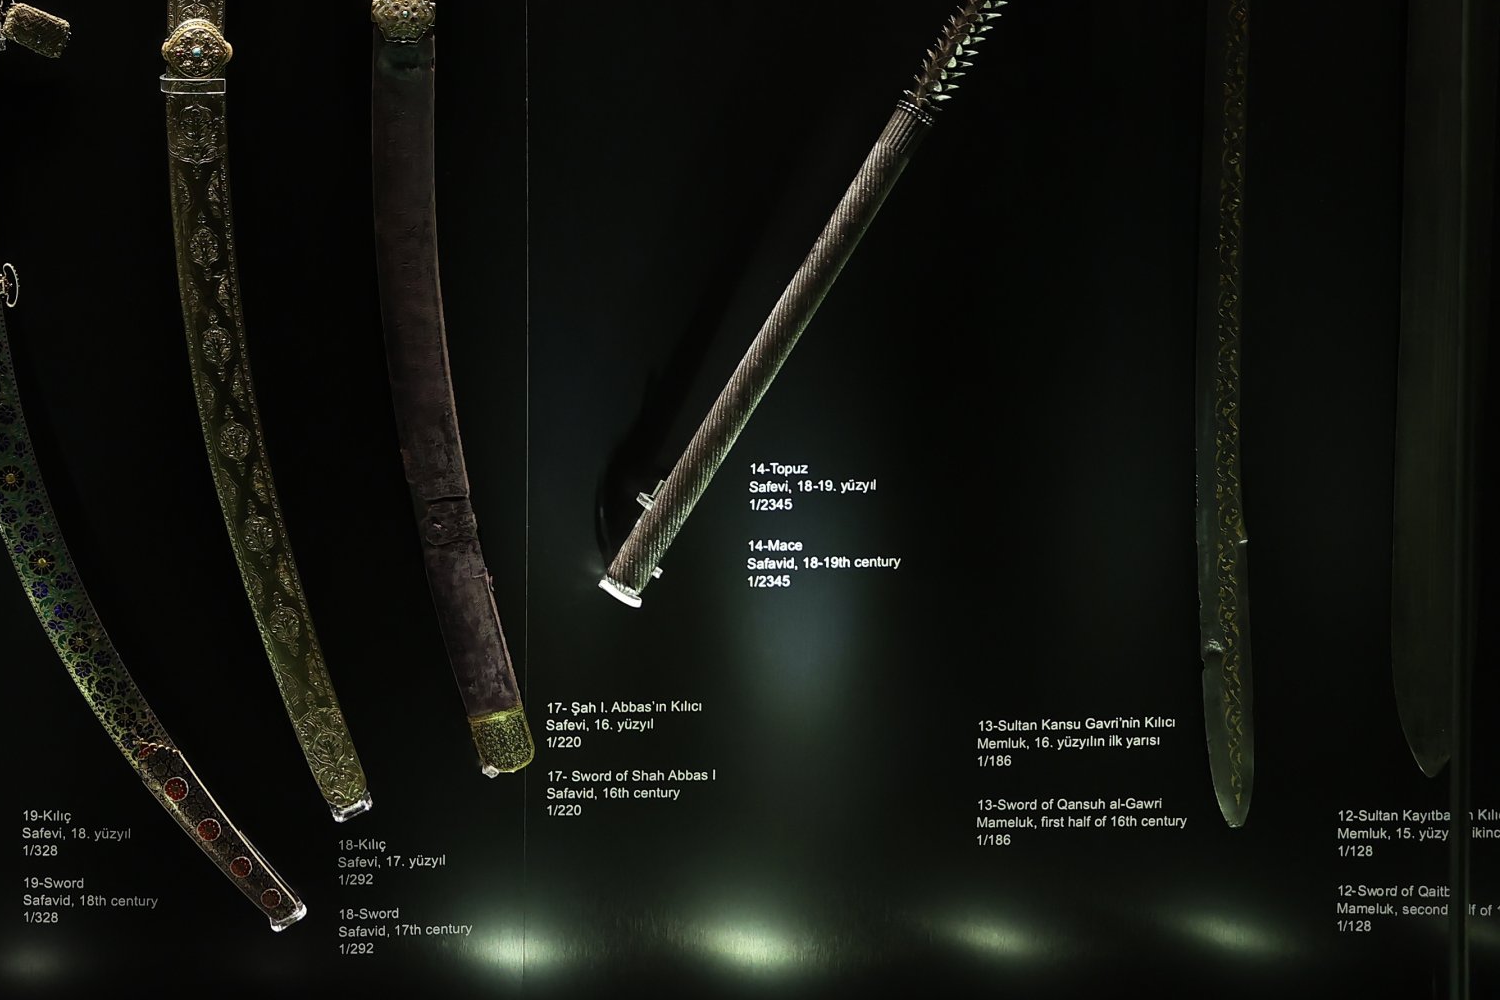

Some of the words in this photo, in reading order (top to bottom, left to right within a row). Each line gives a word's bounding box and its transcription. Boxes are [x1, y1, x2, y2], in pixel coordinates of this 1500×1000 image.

[750, 462, 809, 477] 14-Topuz
[748, 480, 792, 494] Safevi,
[797, 479, 837, 492] 18-19.
[749, 498, 793, 511] 1/2345
[748, 539, 803, 552] 14-Mace
[747, 557, 798, 571] Safavid,
[803, 556, 851, 569] 18-19th
[854, 556, 901, 570] century
[747, 575, 791, 588] 1/2345
[547, 702, 567, 714] 17-
[571, 701, 596, 716] Şah
[545, 719, 589, 732] Safevi,
[594, 718, 613, 730] 16.
[978, 719, 1037, 732] 13-Sultan
[1041, 718, 1081, 730] Kansu
[546, 736, 582, 748] 1/220
[977, 737, 1030, 750] Memluk,
[1035, 736, 1053, 748] 16.
[1109, 734, 1123, 747] ilk
[977, 754, 1012, 767] 1/186
[548, 770, 568, 782] 17-
[571, 770, 612, 782] Sword
[615, 770, 629, 782] of
[631, 770, 665, 782] Shah
[667, 769, 708, 781] Abbas
[546, 787, 597, 800] Safavid,
[603, 787, 629, 799] 16th
[633, 787, 681, 801] century
[547, 804, 582, 816] 1/220
[978, 799, 1037, 811] 13-Sword
[1041, 798, 1054, 810] of
[1057, 798, 1106, 810] Qansuh
[1109, 797, 1162, 810] al-Gawri
[976, 816, 1037, 829] Mameluk,
[1041, 816, 1064, 828] first
[1068, 815, 1091, 828] half
[1111, 815, 1137, 827] 16th
[1141, 815, 1187, 829] century
[1338, 809, 1398, 822] 12-Sultan
[22, 827, 66, 840] Safevi,
[71, 827, 90, 839] 18.
[977, 834, 1011, 846] 1/186
[1337, 827, 1391, 840] Memluk,
[1396, 827, 1415, 839] 15.
[23, 844, 58, 857] 1/328
[1338, 845, 1373, 857] 1/128
[338, 856, 381, 869] Safevi,
[386, 855, 405, 867] 17.
[24, 877, 84, 889] 19-Sword
[338, 873, 373, 885] 1/292
[1338, 884, 1398, 897] 12-Sword
[23, 894, 74, 907] Safavid,
[80, 894, 106, 906] 18th
[111, 896, 158, 909] century
[339, 907, 399, 920] 18-Sword
[1337, 902, 1398, 916] Mameluk,
[1402, 904, 1448, 915] second
[23, 911, 59, 923] 1/328
[338, 925, 390, 938] Safavid,
[395, 924, 421, 936] 17th
[425, 924, 473, 936] century
[1337, 920, 1372, 932] 1/128
[339, 942, 374, 954] 1/292
